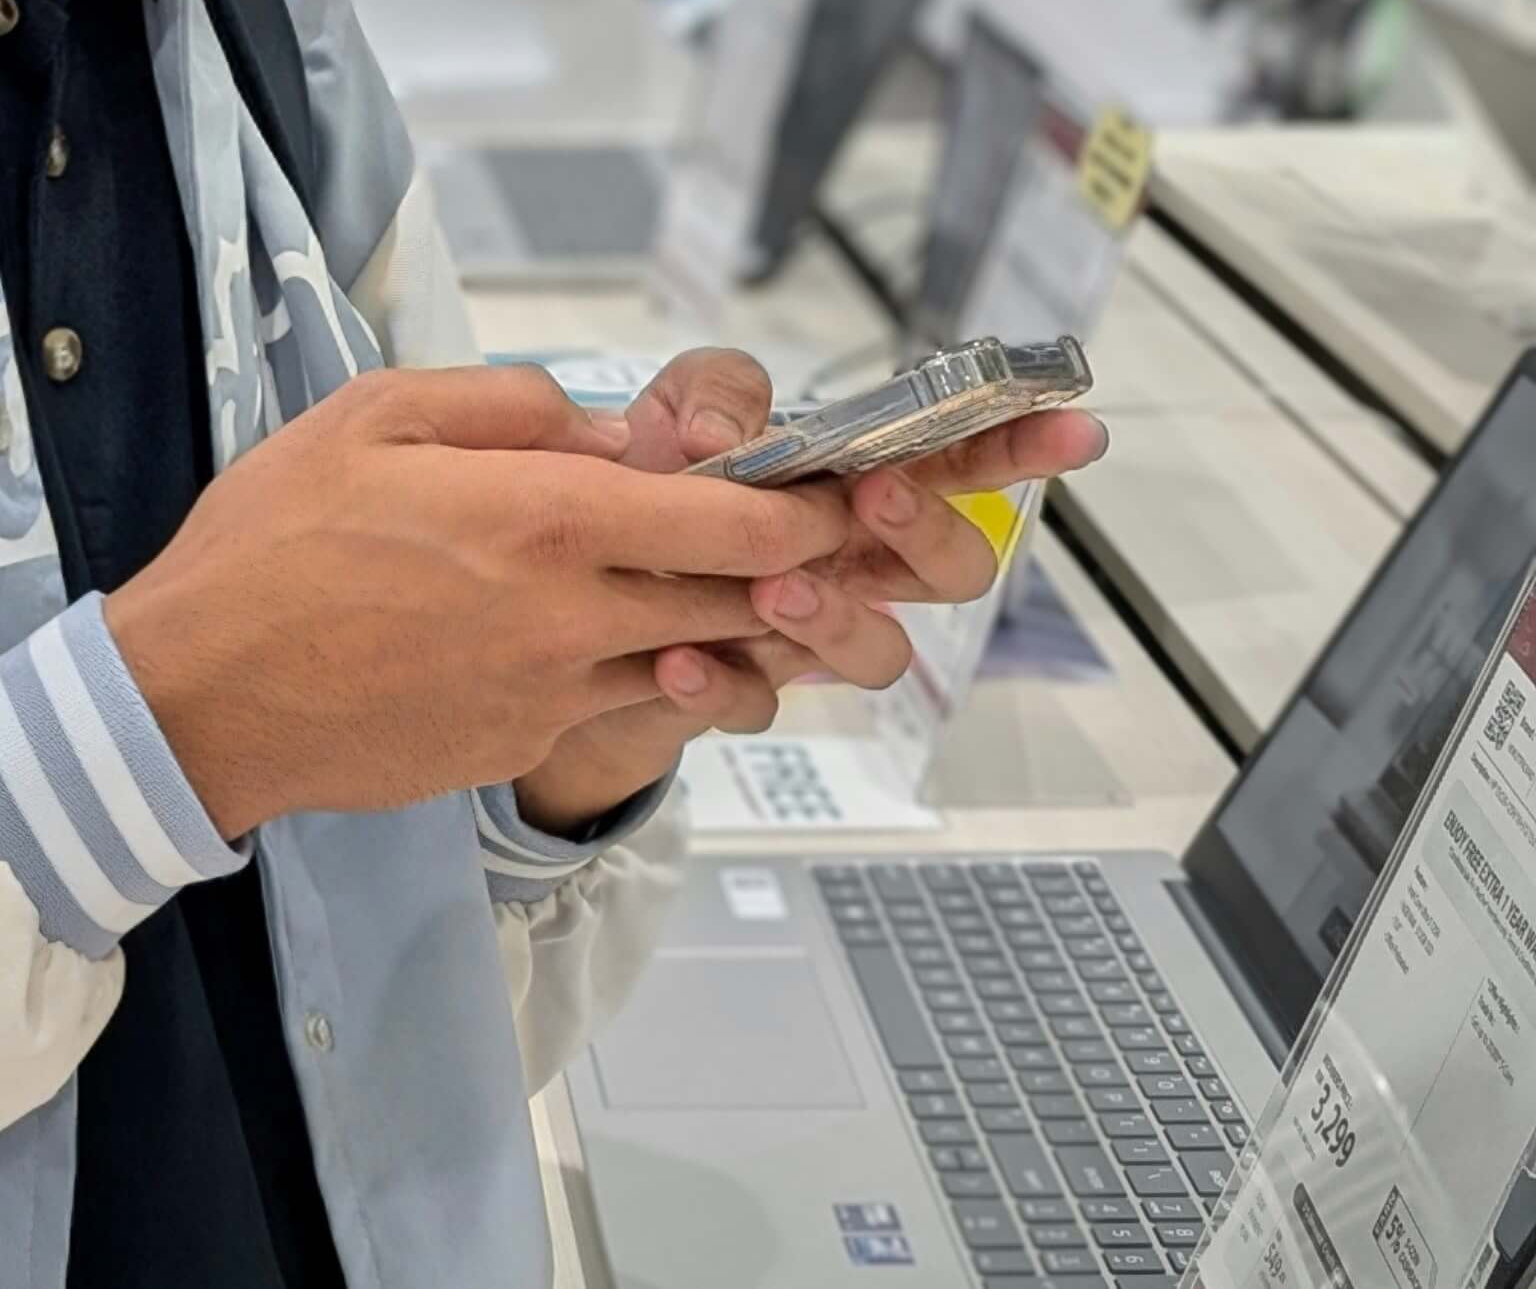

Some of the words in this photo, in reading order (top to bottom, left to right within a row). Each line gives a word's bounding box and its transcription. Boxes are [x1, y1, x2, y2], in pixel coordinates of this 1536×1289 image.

[1462, 837, 1486, 874] FREE
[1478, 861, 1506, 907] EXTRA
[1505, 899, 1530, 941] YEAR
[1310, 1081, 1357, 1168] 3,299
[1385, 1213, 1407, 1255] 5%
